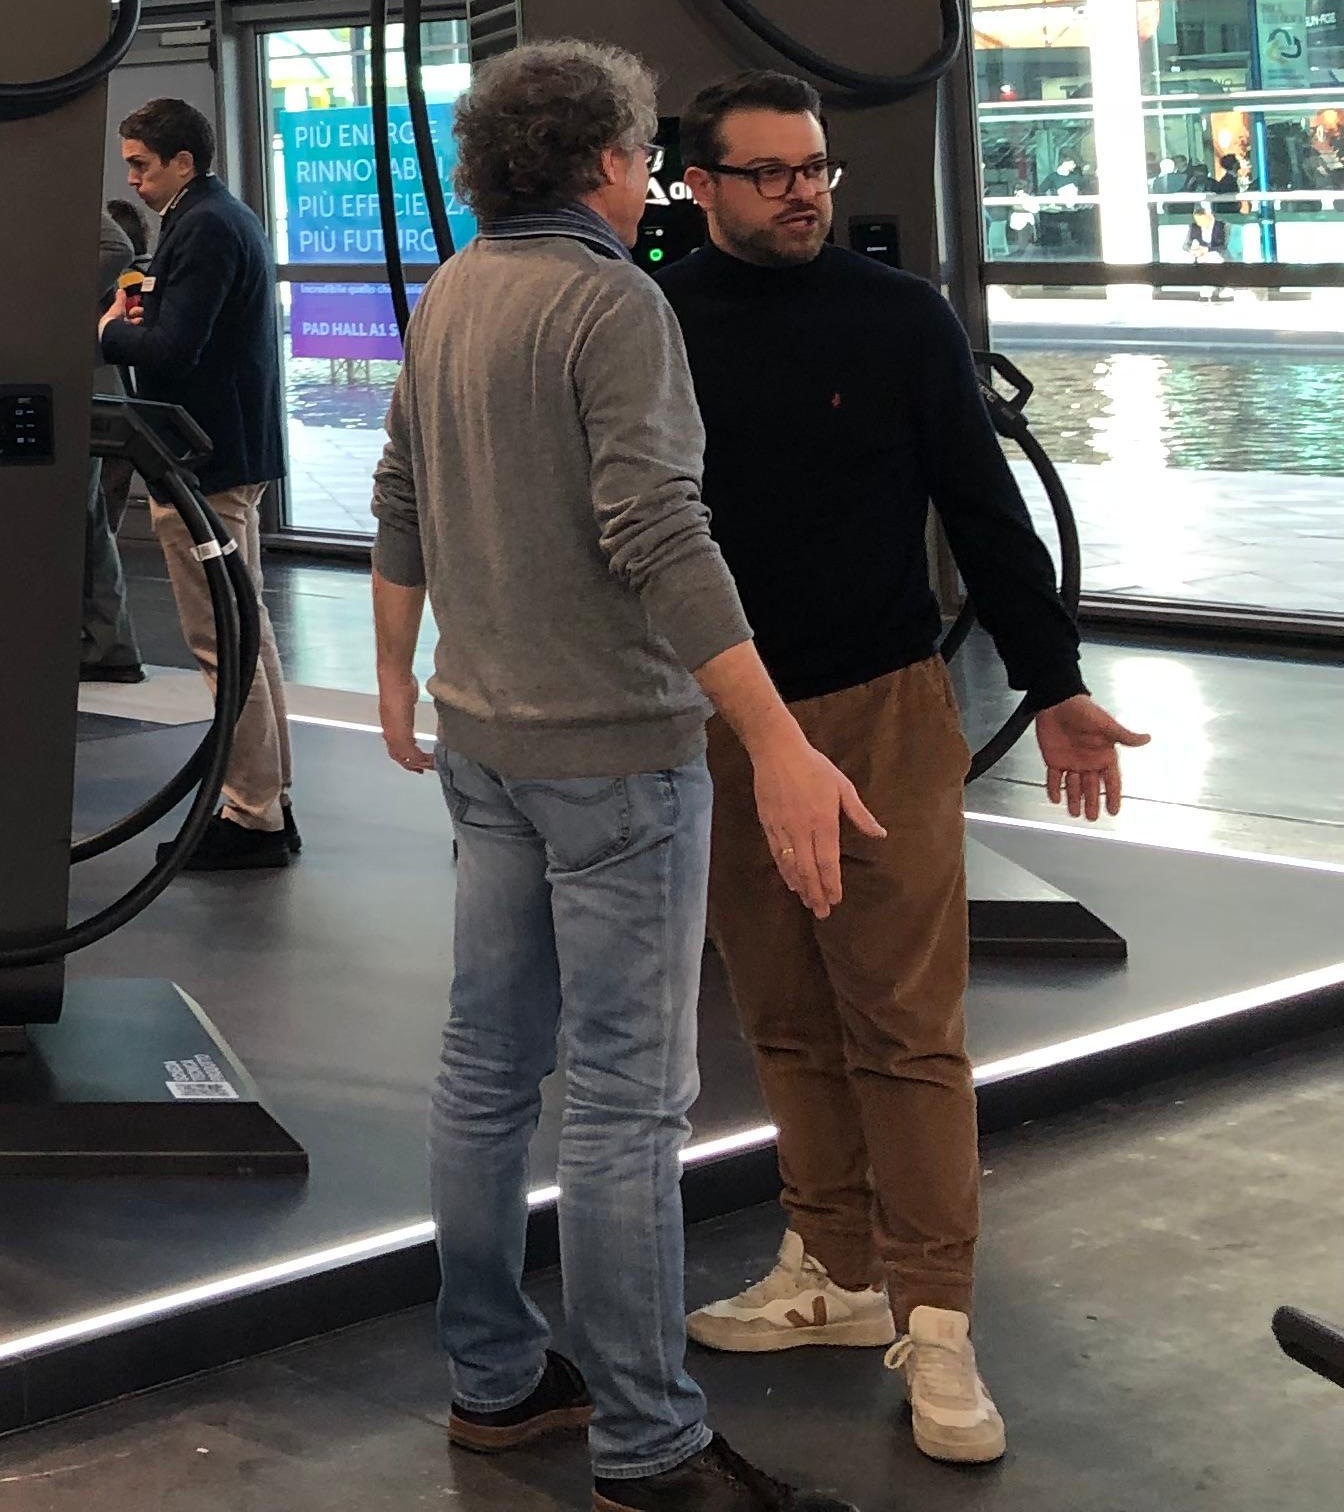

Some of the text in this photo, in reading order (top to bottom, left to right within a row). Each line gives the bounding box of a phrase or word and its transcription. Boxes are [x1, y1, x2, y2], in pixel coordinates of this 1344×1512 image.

[295, 120, 331, 149] PIÙ
[299, 190, 334, 218] PIÙ
[299, 224, 335, 252] PIÙ
[302, 321, 330, 336] PAD
[332, 322, 367, 336] HALL
[369, 322, 387, 336] A1
